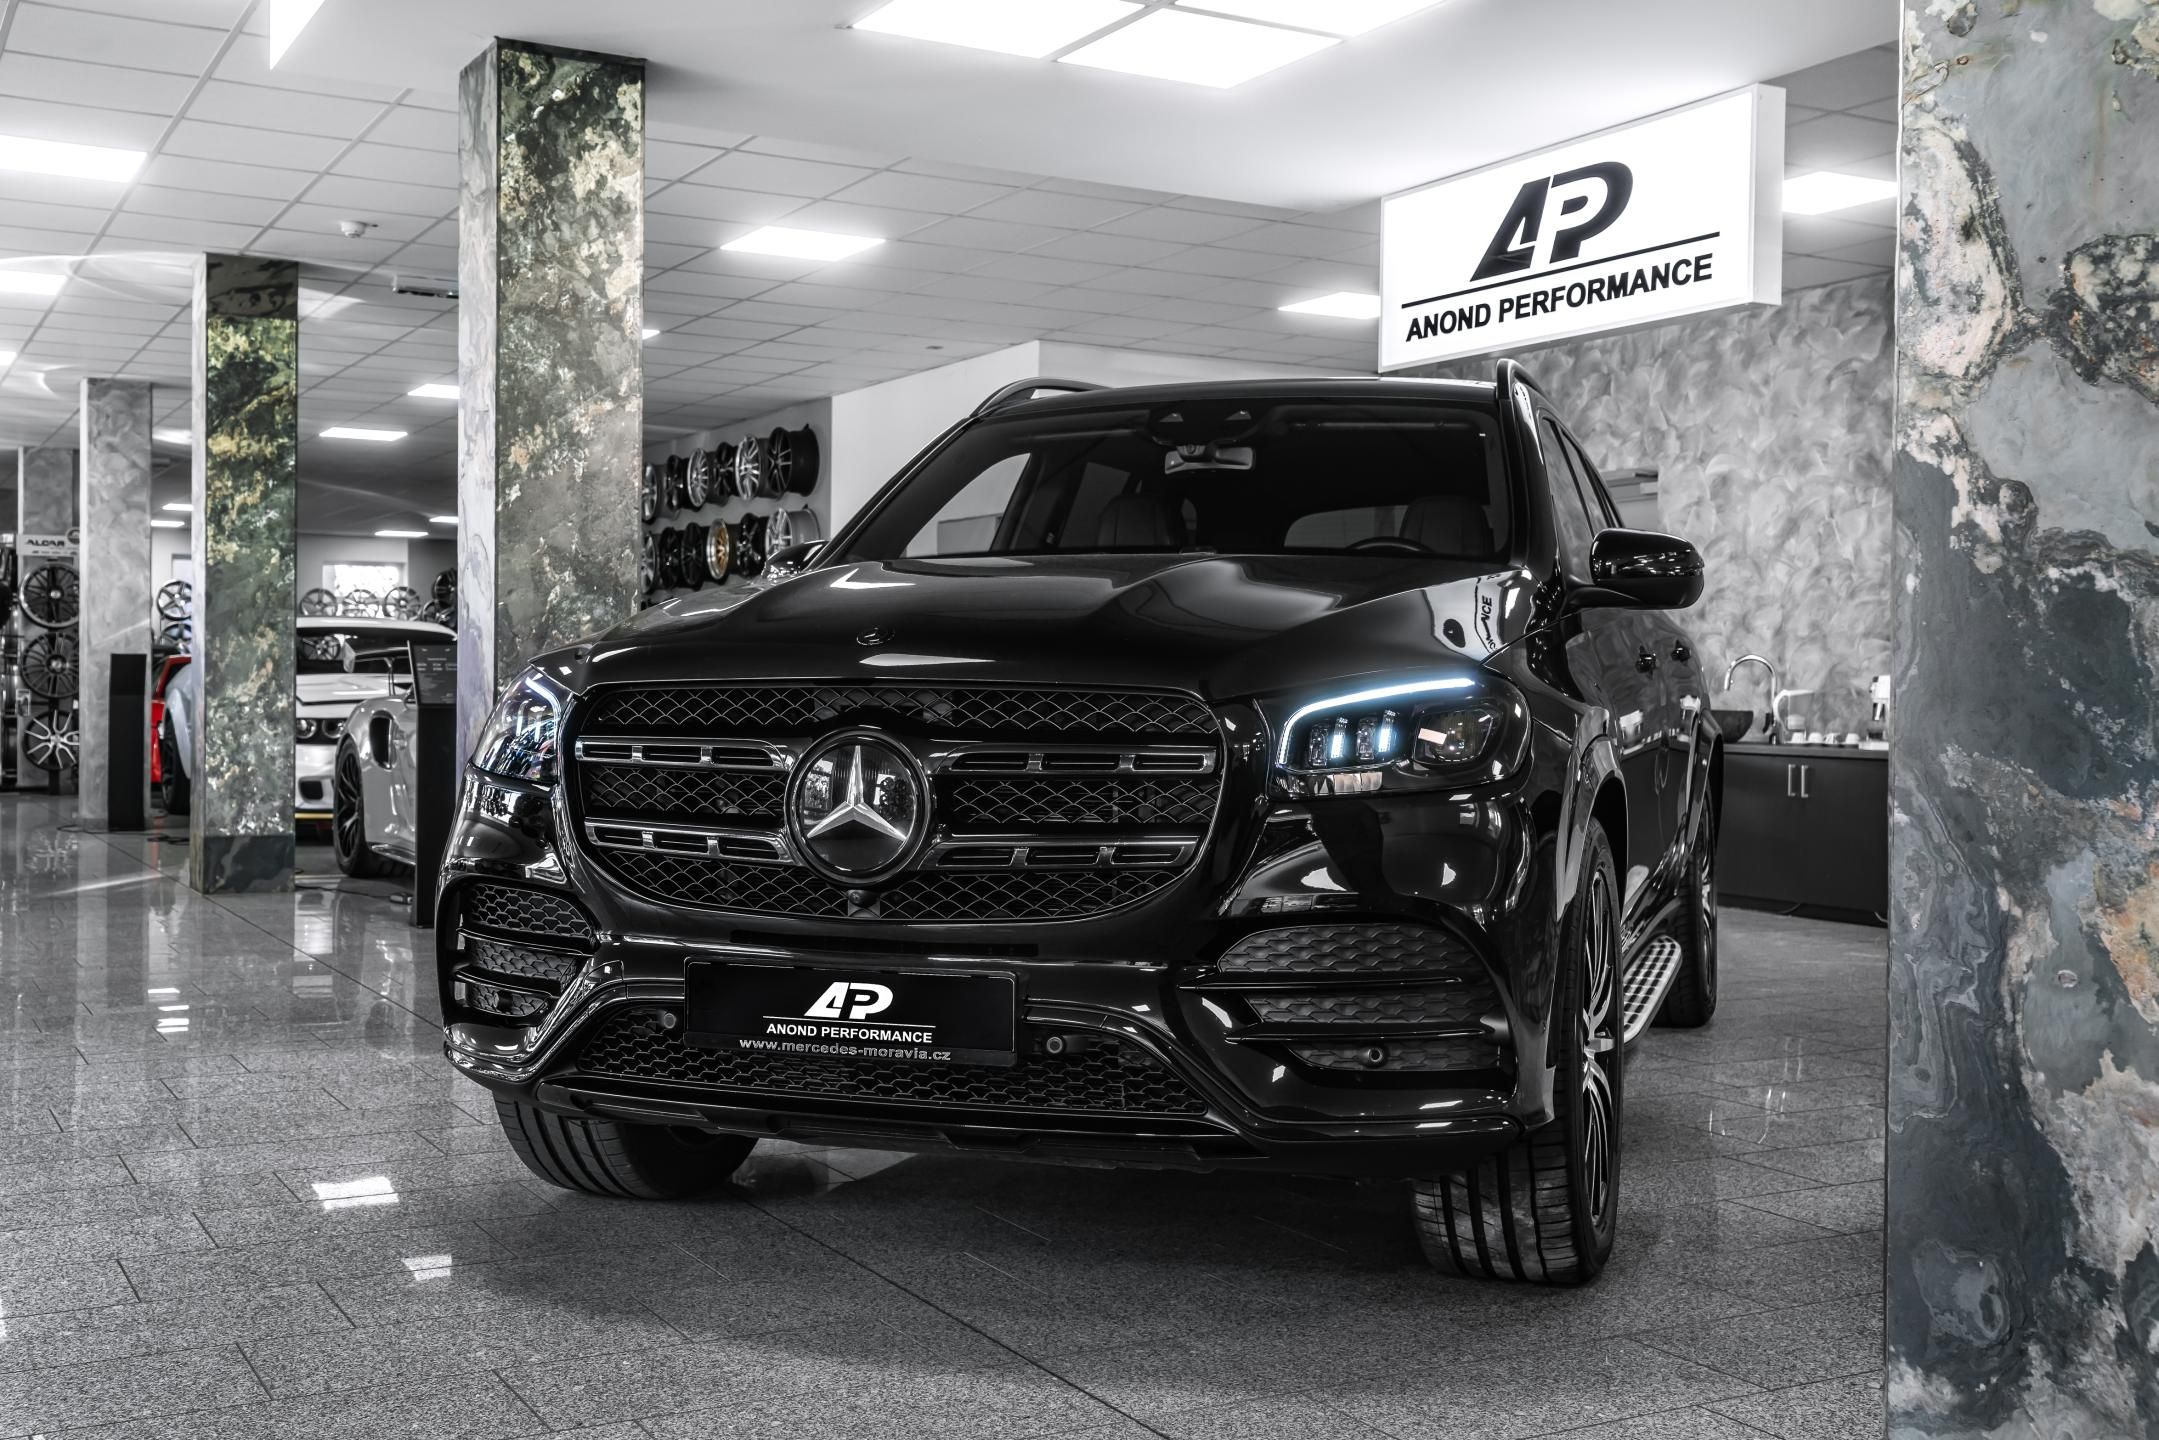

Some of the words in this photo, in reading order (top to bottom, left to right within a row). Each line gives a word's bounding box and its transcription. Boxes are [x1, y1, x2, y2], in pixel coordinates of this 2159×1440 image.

[1469, 161, 1634, 282] AP
[1405, 303, 1491, 342] ANOND
[1498, 252, 1713, 323] PERFORMANCE
[803, 981, 894, 1020] AP
[739, 1039, 952, 1061] www.mercedes-moravia.cz
[765, 1023, 818, 1037] ANOND
[821, 1026, 933, 1044] PERFORMANCE
